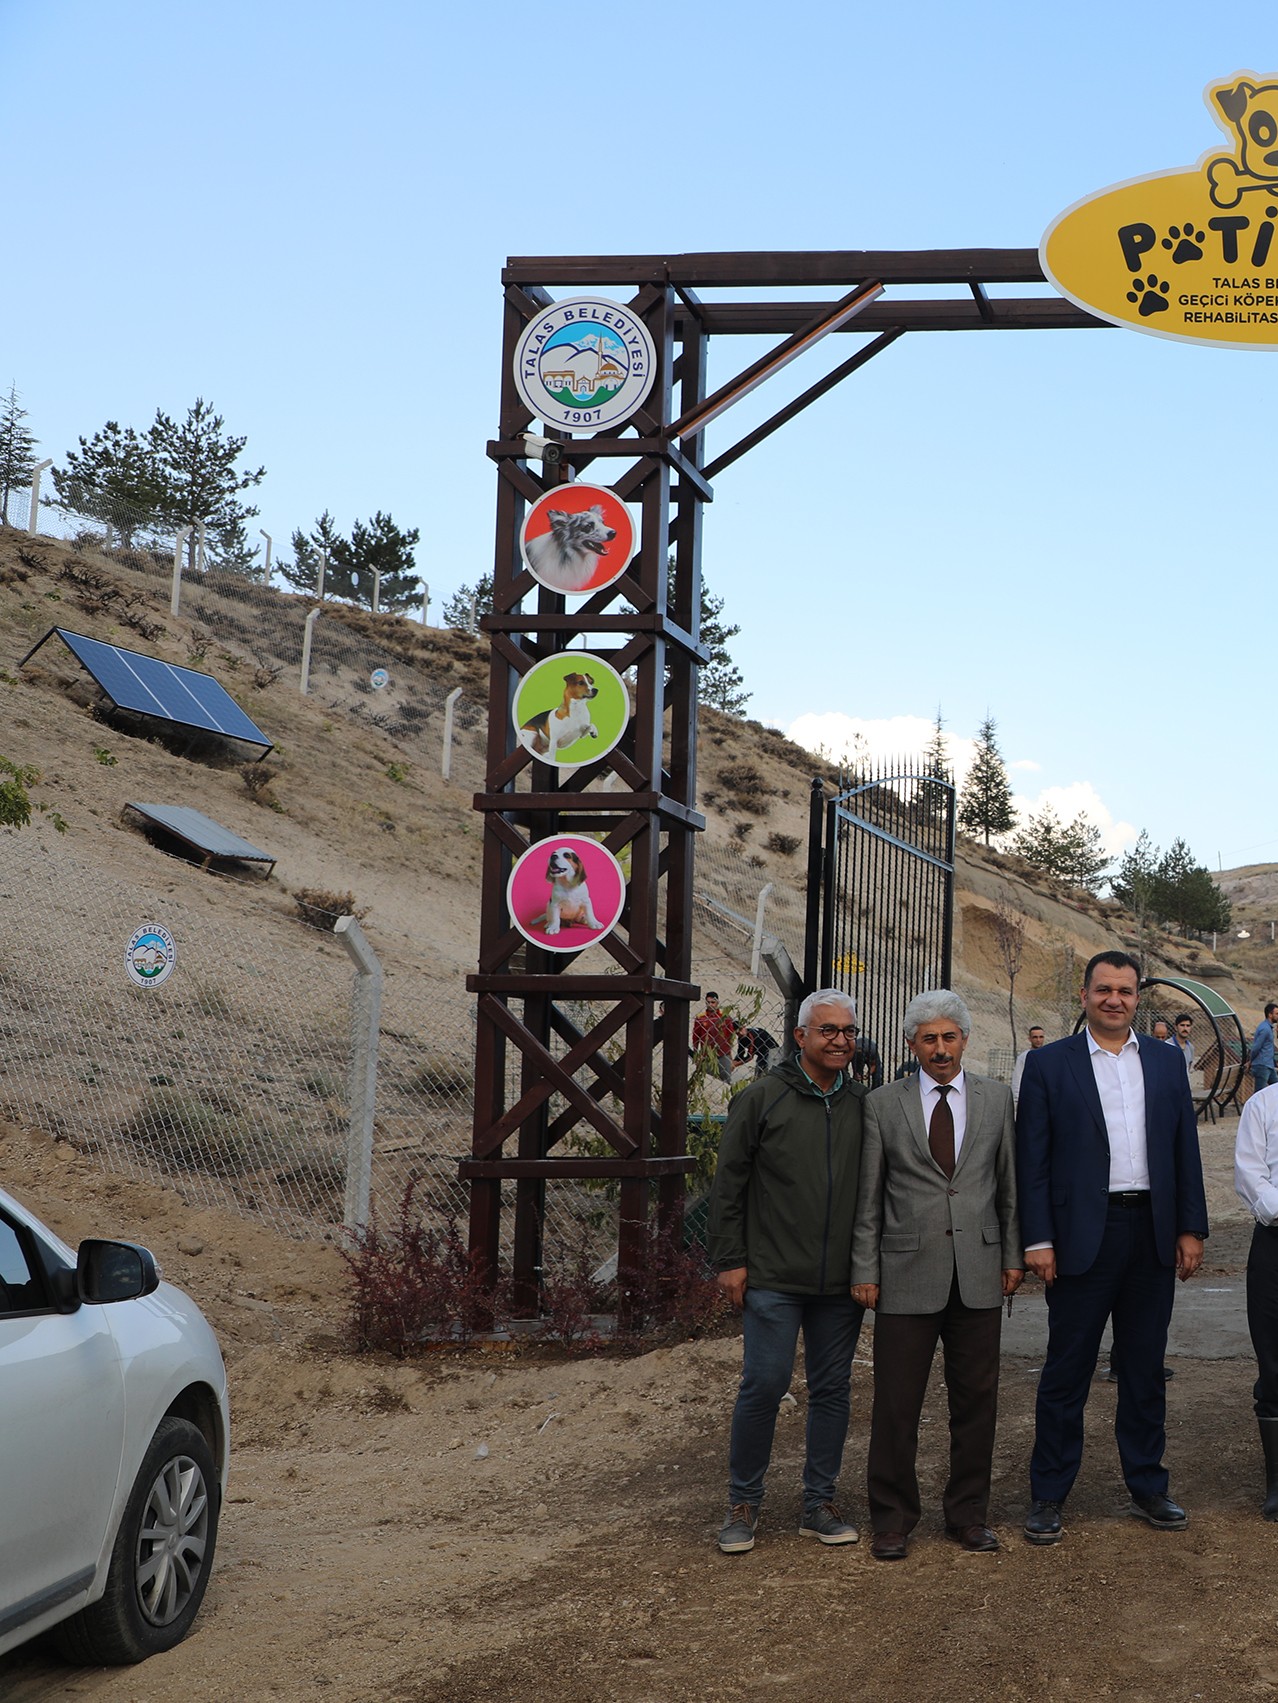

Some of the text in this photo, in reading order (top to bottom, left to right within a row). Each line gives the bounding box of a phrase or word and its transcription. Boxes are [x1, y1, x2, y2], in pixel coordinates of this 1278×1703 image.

[1212, 277, 1261, 289] TALAS
[524, 307, 646, 380] TALAS BELEDİYESİ
[563, 409, 602, 423] 1907
[127, 934, 139, 962] TALAS
